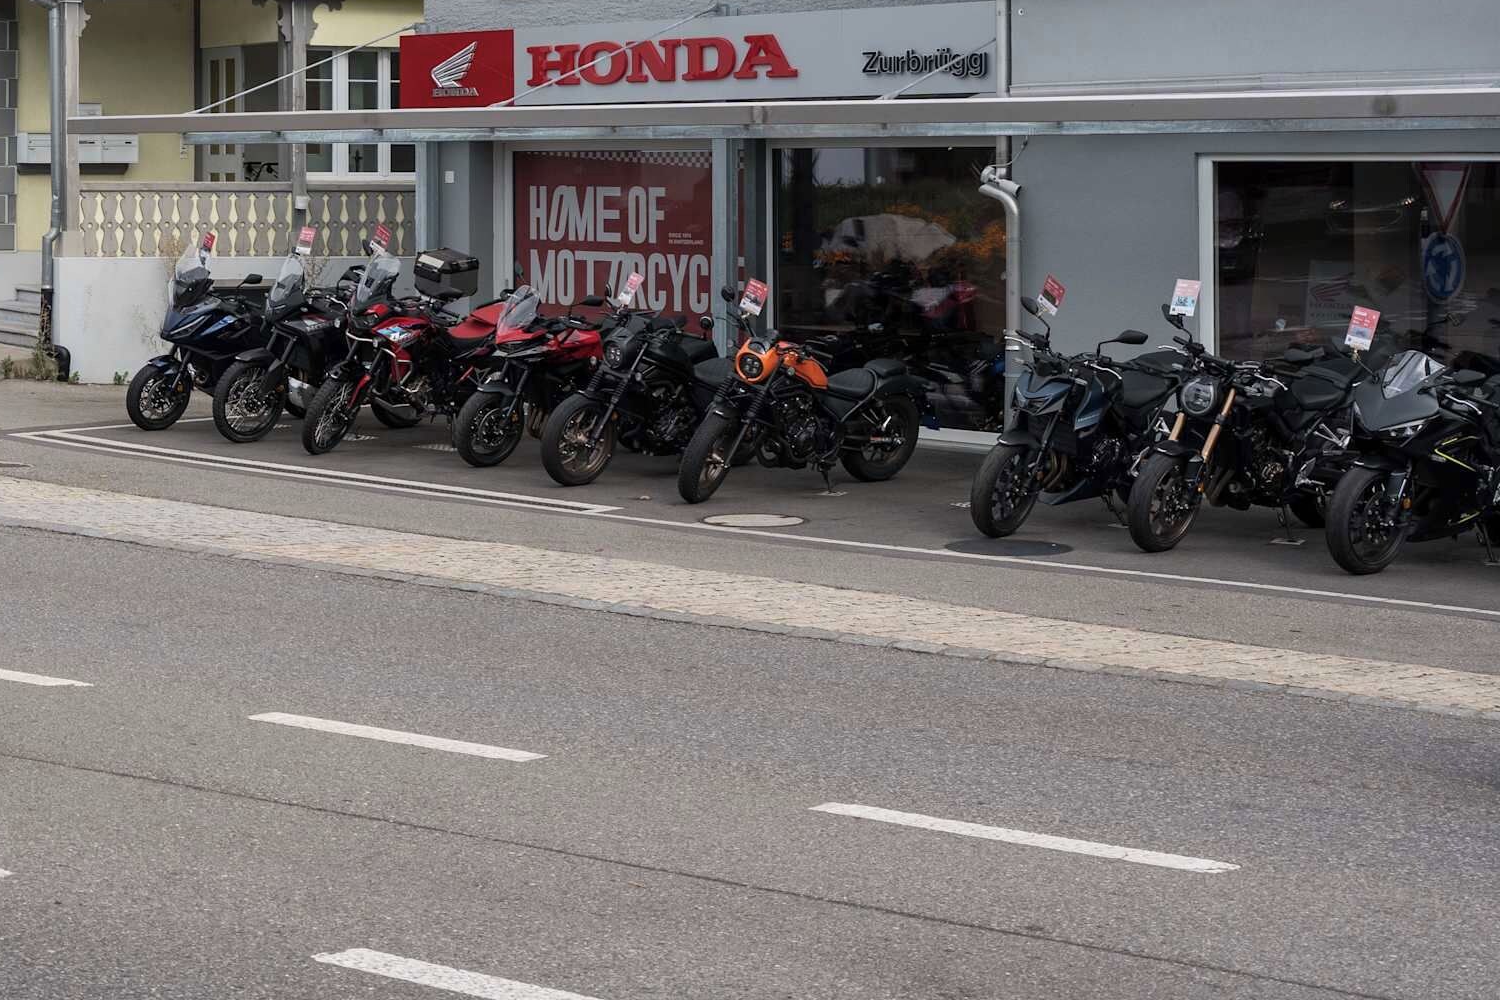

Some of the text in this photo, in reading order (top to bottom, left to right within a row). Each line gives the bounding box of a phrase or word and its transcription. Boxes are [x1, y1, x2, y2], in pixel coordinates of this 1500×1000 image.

[526, 33, 990, 87] HONDA Zurbrügg
[628, 186, 667, 244] OF
